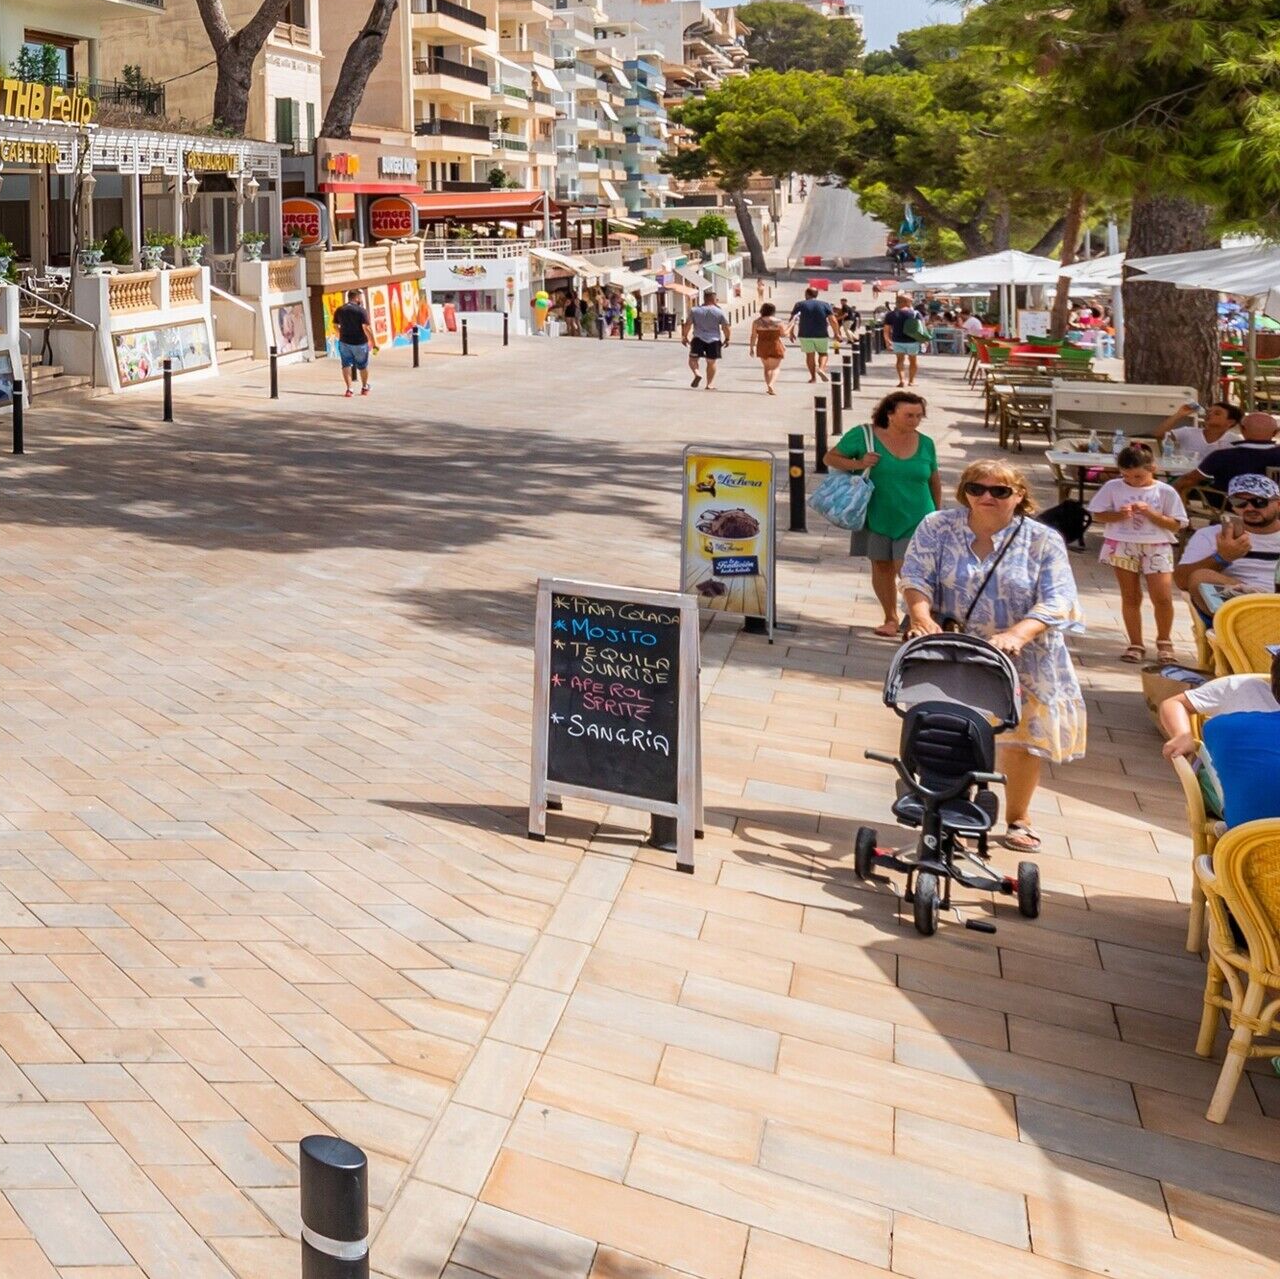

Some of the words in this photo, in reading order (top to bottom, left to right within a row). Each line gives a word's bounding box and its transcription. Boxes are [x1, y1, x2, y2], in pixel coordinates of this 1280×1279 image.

[3, 79, 45, 119] THB
[50, 85, 92, 130] Felip
[0, 140, 60, 163] CAFETERIA
[282, 214, 319, 223] URGER
[371, 210, 411, 218] BURGER
[371, 218, 411, 230] KING
[570, 641, 670, 670] TEQUILA
[581, 656, 669, 684] SUNRISE
[570, 675, 655, 702] APEROL
[583, 691, 652, 722] SPRITZ
